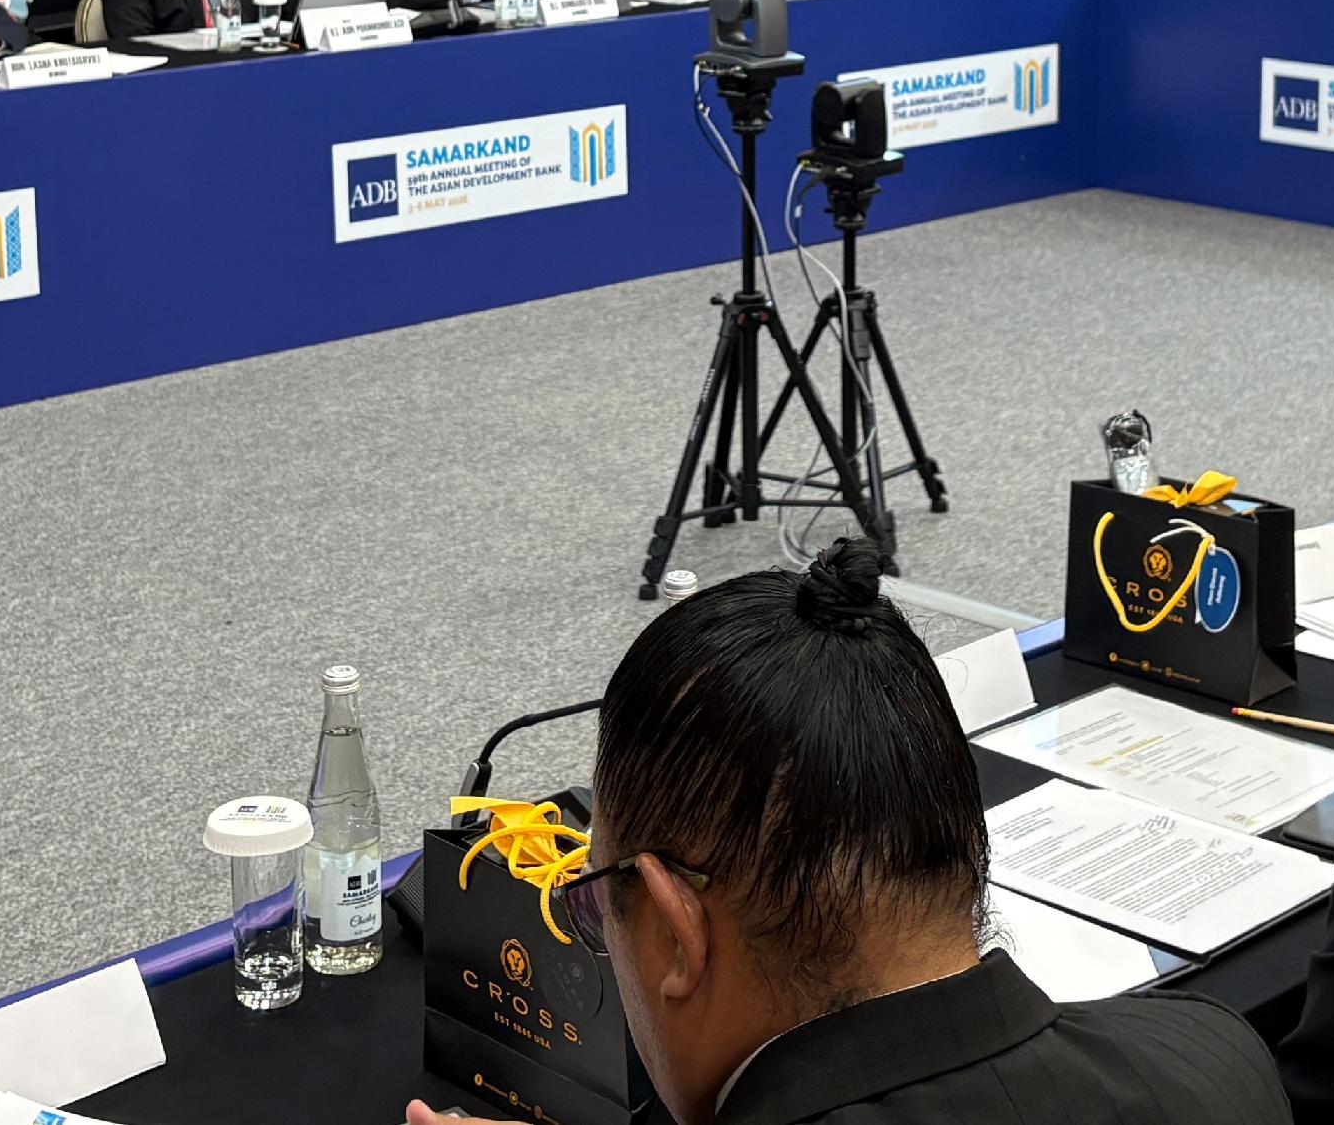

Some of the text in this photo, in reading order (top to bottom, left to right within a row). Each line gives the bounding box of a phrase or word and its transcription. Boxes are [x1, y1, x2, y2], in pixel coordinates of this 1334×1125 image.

[891, 68, 986, 97] SAMARKAND
[1275, 96, 1317, 121] ADB
[406, 135, 531, 168] SAMARKAND
[408, 163, 562, 197] THE ASIAN DEVELOPMENT BANK
[430, 165, 472, 180] ANNUAL
[474, 159, 517, 174] MEETING
[519, 156, 531, 168] OF
[350, 179, 398, 209] ADB
[463, 970, 579, 1043] CROSS
